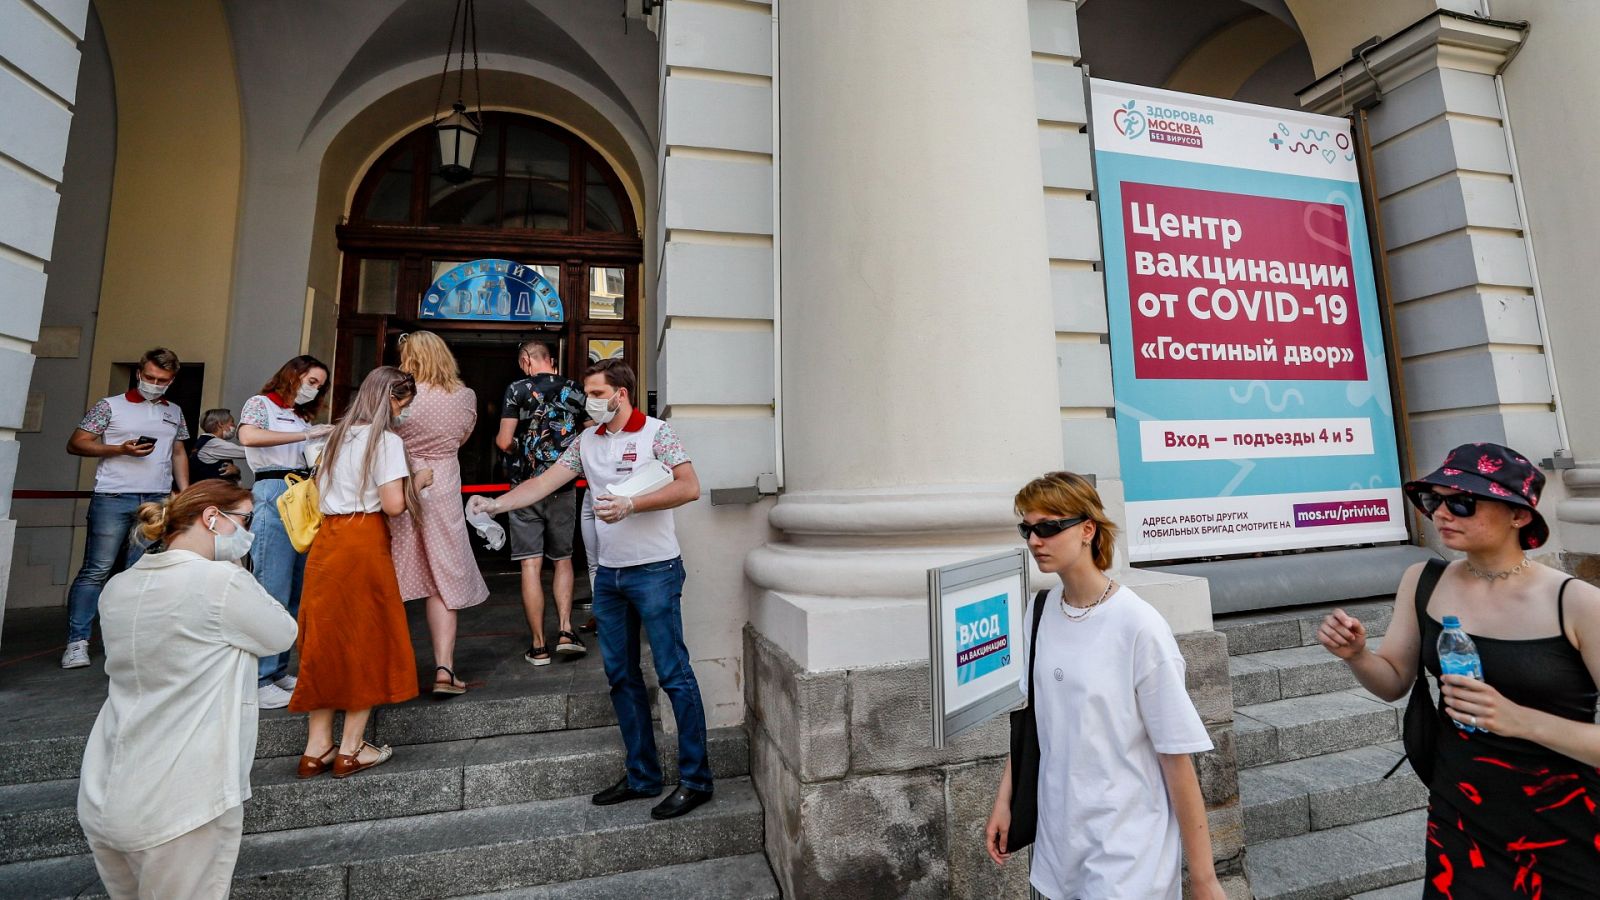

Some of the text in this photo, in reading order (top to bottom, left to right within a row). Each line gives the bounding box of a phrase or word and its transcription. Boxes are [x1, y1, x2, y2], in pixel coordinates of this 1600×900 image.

[1146, 106, 1214, 124] ЗДОРОВАЯ
[1148, 119, 1201, 135] МОСКВА
[1151, 132, 1201, 145] БЕЗ ВИРУСОВ
[1130, 201, 1243, 249] Центр
[1134, 251, 1349, 290] вакцинации
[423, 264, 560, 320] ГОСТИНЫЙ ДВОР
[456, 290, 532, 316] ВХОД
[1137, 287, 1348, 326] от COVID-19
[1140, 336, 1354, 369] «Гостиный двор»
[1164, 431, 1209, 449] Вход
[1233, 430, 1315, 448] подъезды
[1318, 429, 1329, 444] 4
[1332, 431, 1342, 443] и
[1345, 427, 1354, 443] 5
[1142, 511, 1249, 527] АДРЕСА РАБОТЫ ДРУГИХ
[1297, 505, 1388, 522] mos.ru/privivka
[1143, 520, 1291, 539] МОБИЛЬНЫХ БРИГАД СМОТРИТЕ НА
[960, 614, 999, 645] ВХОД
[960, 638, 1006, 663] НА ВАКЦИНАЦИЮ
